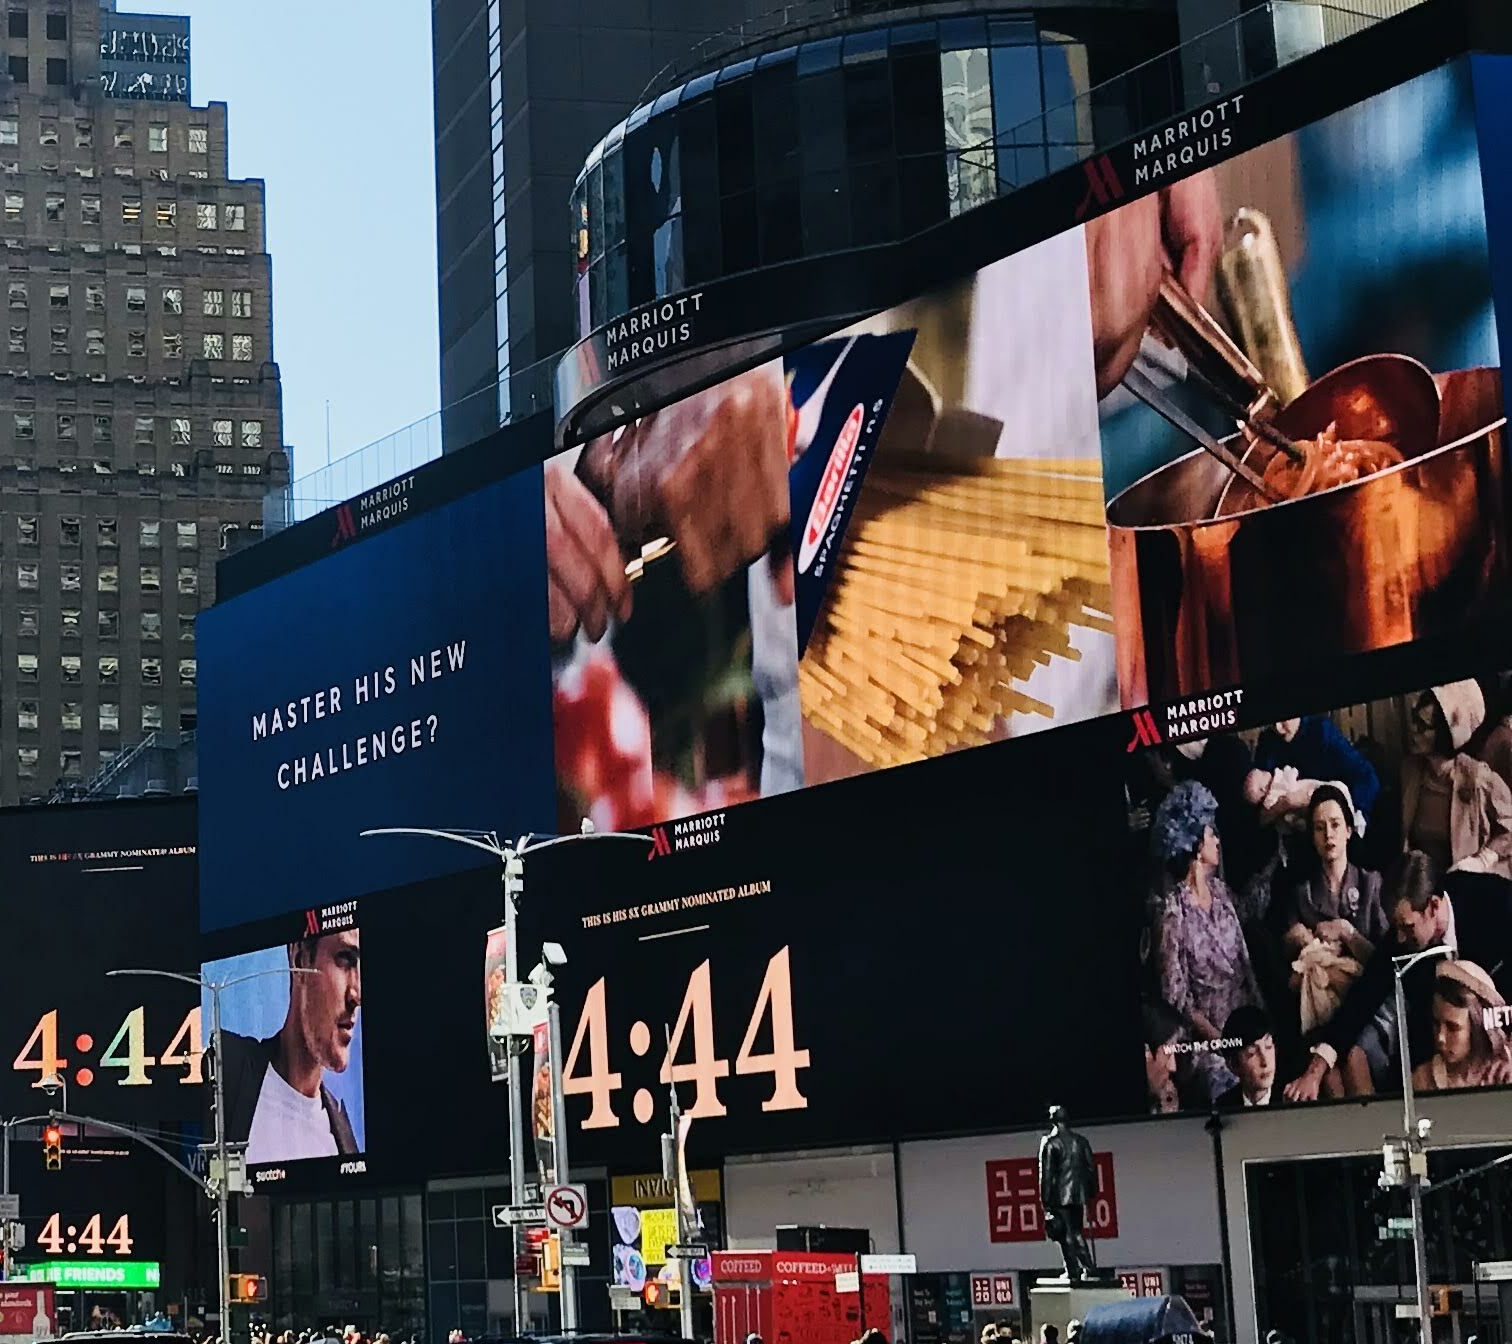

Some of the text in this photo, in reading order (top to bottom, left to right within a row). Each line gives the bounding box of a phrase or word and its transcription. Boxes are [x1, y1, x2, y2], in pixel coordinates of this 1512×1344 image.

[1133, 95, 1244, 160] MARRIOTT
[1135, 128, 1232, 186] MARQUIS
[607, 293, 703, 347] MARRIOTT
[608, 323, 690, 371] MARQUIS
[360, 476, 415, 511] MARRIOTT
[361, 497, 409, 529] MARQUIS
[252, 640, 467, 741] MASTER HIS NEW
[1166, 689, 1244, 720] MARRIOTT
[1168, 710, 1236, 738] MARQUIS
[277, 714, 439, 791] CHALLENGE?
[674, 813, 726, 836] MARRIOTT
[675, 830, 721, 851] MARQUIS
[321, 900, 358, 918] MARRIOTT
[582, 914, 601, 929] THIS
[602, 912, 612, 924] IS
[612, 909, 628, 923] HIS
[640, 898, 681, 918] GRAMMY
[681, 886, 736, 910] NOMINATED
[737, 880, 772, 899] ALBUM
[13, 1005, 204, 1089] 4:44
[562, 944, 811, 1130] 4:44
[37, 1212, 134, 1255] 4:44
[63, 1267, 126, 1282] FRIENDS
[776, 1261, 827, 1275] COFFEED
